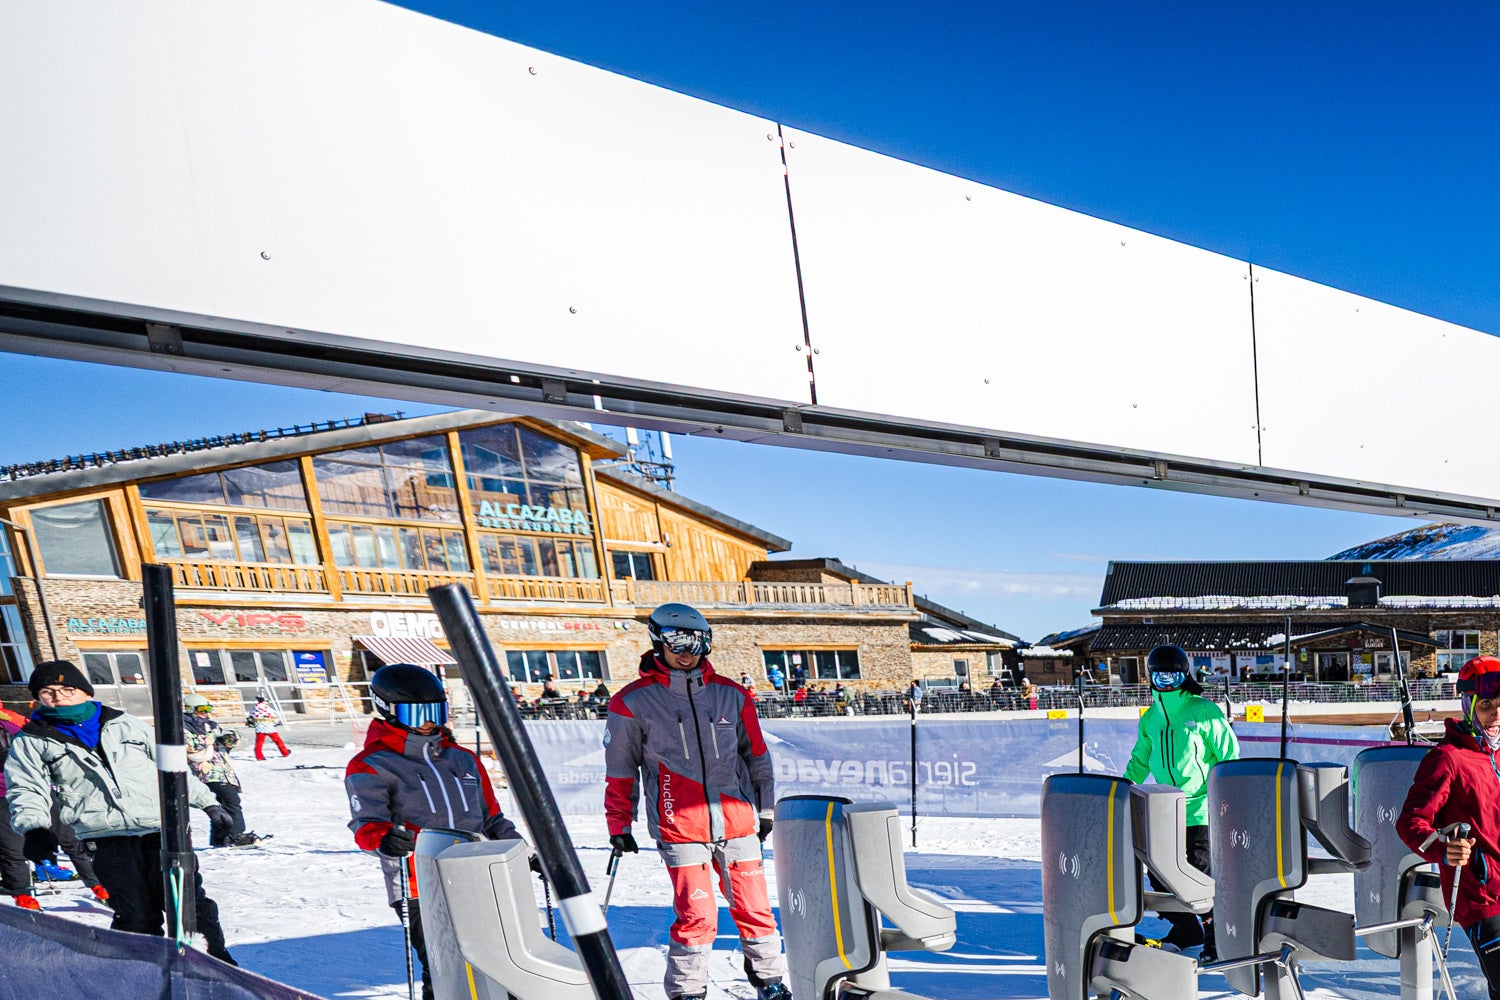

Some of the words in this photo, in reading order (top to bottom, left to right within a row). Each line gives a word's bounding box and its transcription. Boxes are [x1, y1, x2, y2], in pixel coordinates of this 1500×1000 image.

[480, 500, 588, 525] ALCAZABA
[481, 518, 591, 535] RESTAURANTE
[67, 617, 147, 628] ALCAZABA
[199, 611, 306, 627] VIPS
[500, 620, 564, 630] CENTRAL
[564, 621, 601, 631] GRILL
